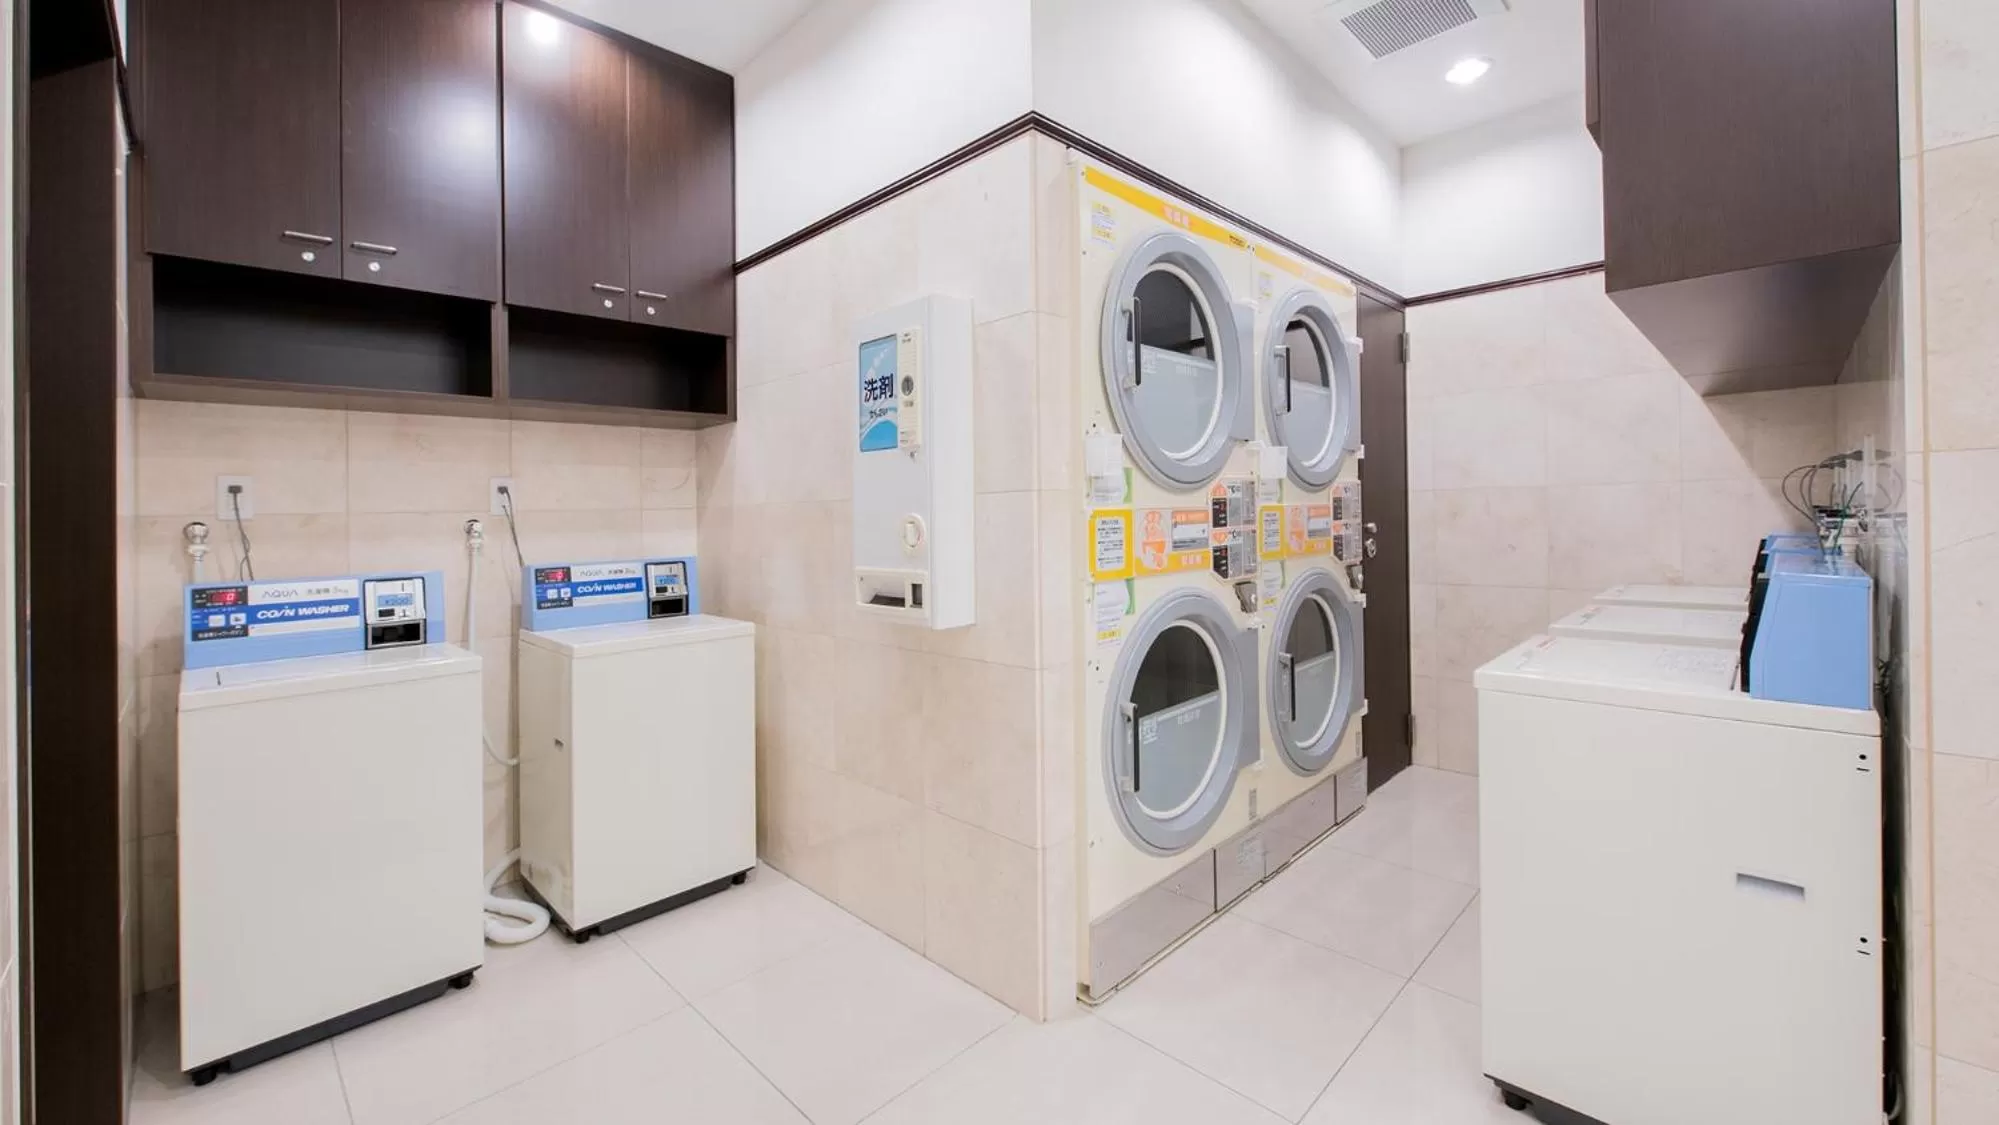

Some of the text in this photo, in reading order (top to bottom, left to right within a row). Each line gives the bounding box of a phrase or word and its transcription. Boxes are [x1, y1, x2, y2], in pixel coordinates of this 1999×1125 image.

[863, 373, 895, 403] 洗剤
[261, 588, 299, 599] AQUA
[577, 583, 602, 594] COIN
[257, 605, 296, 619] COIN
[297, 603, 350, 616] WASHER
